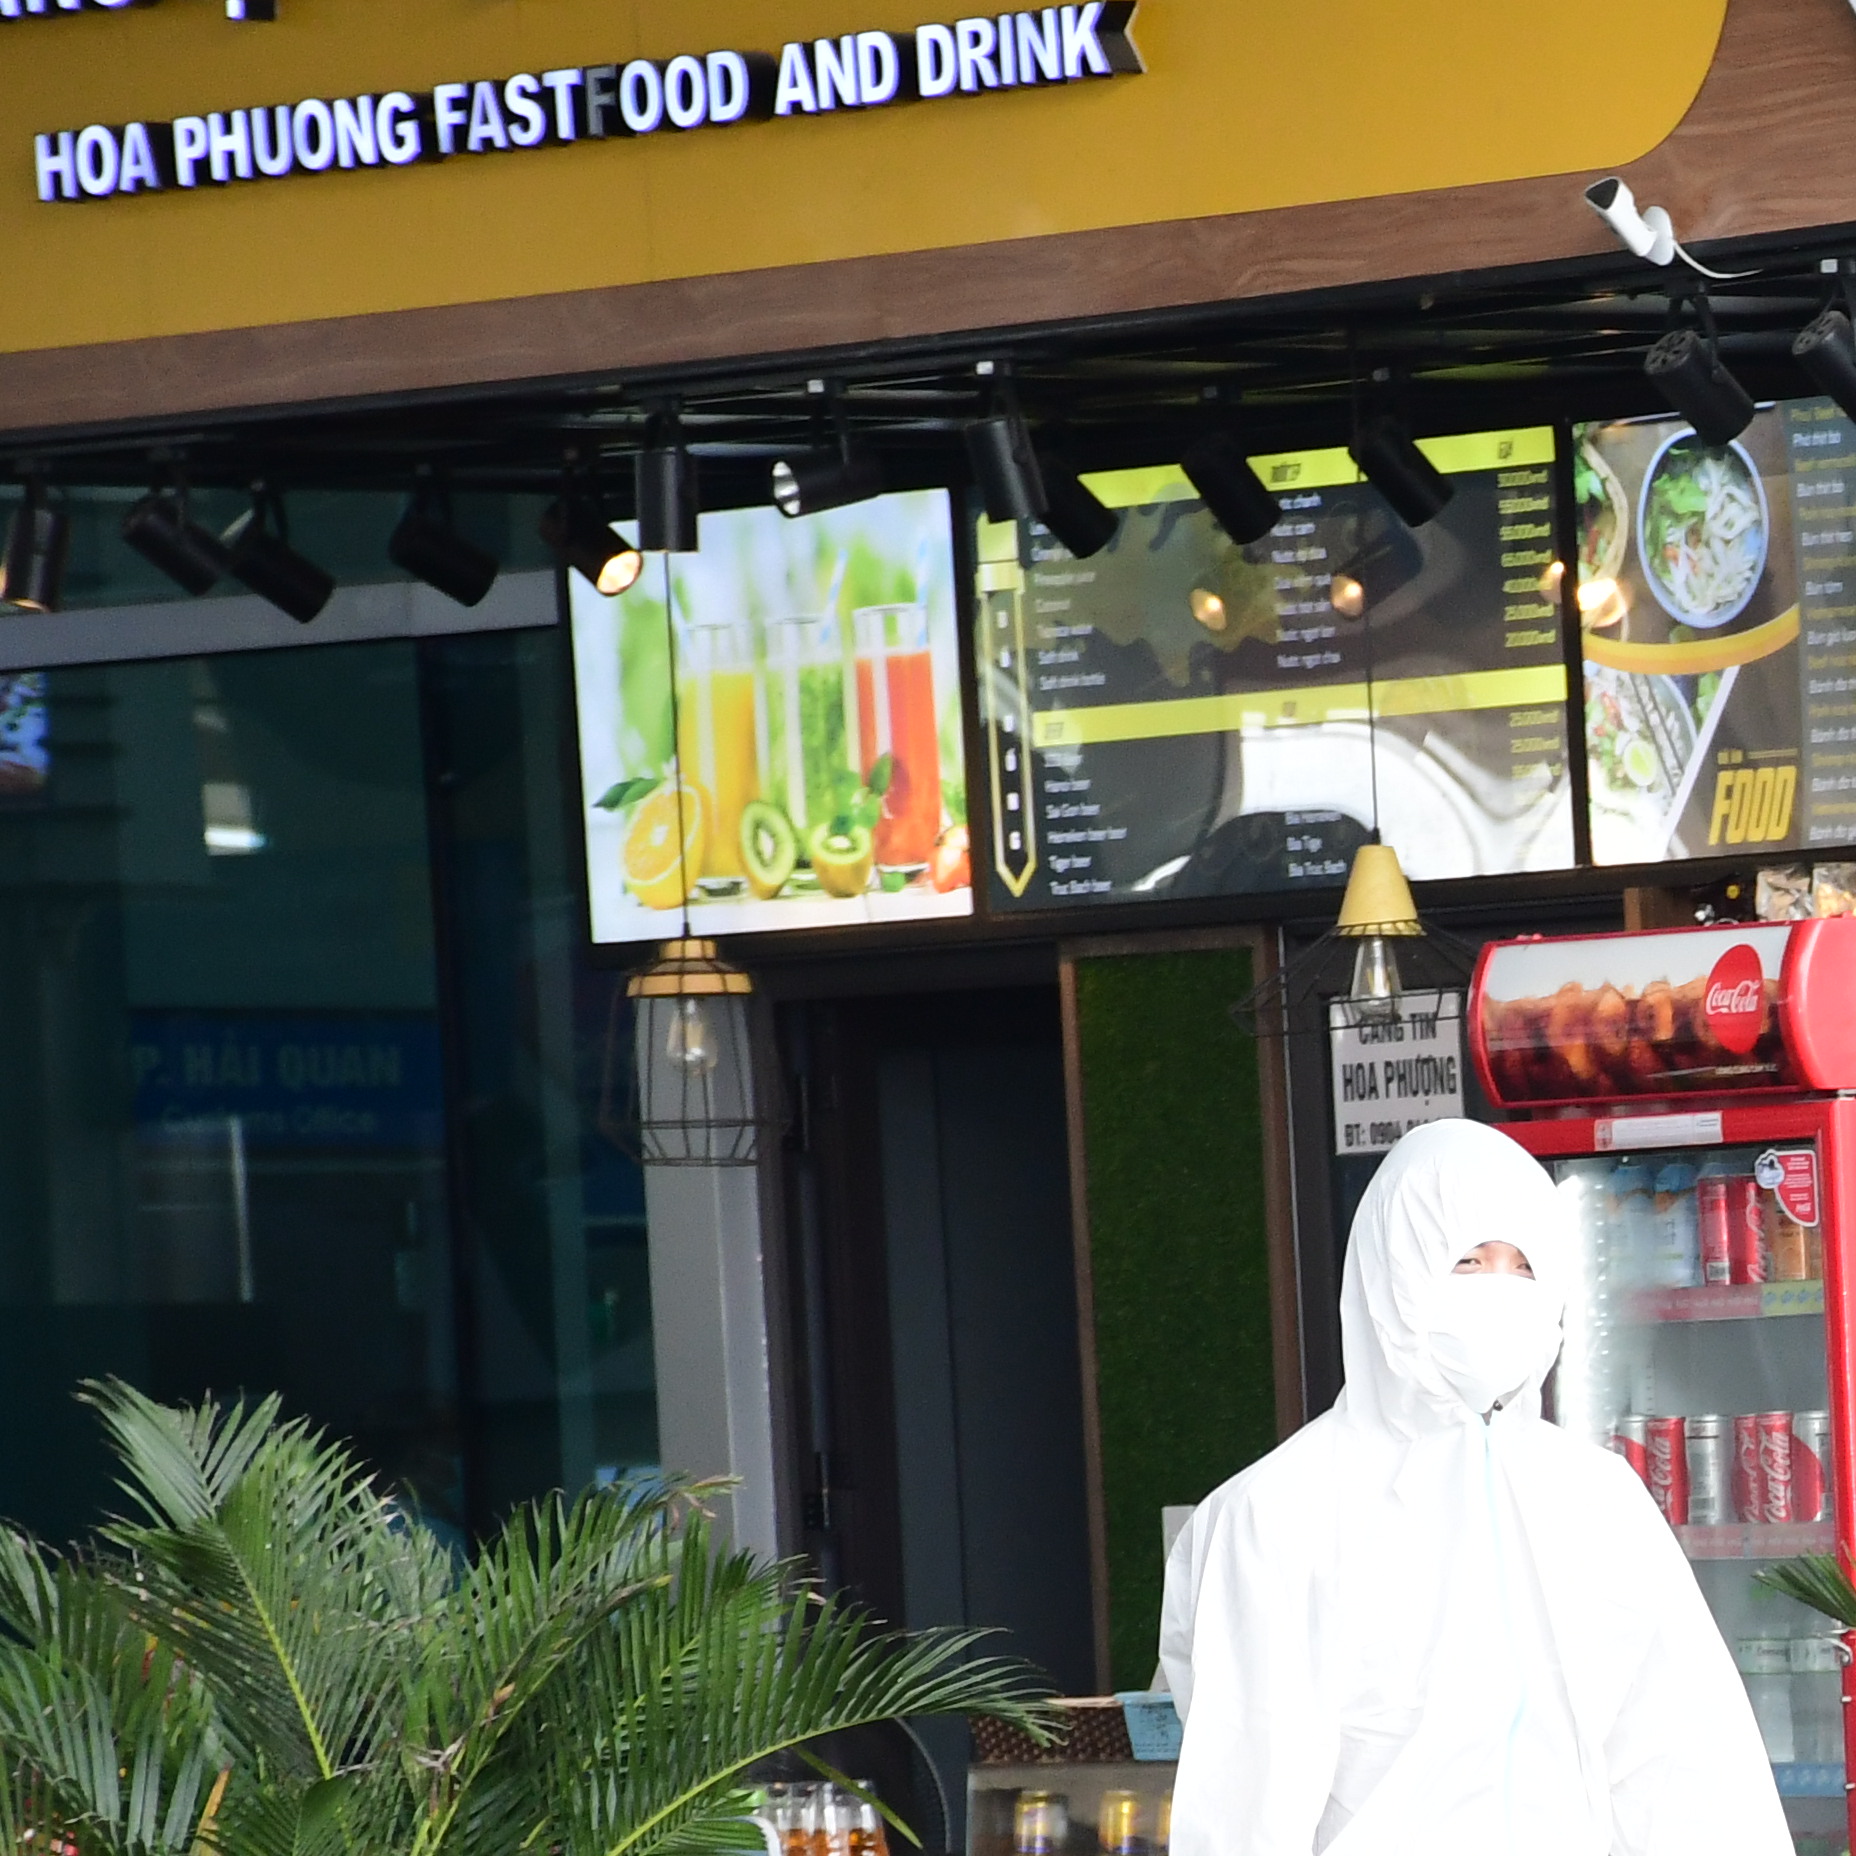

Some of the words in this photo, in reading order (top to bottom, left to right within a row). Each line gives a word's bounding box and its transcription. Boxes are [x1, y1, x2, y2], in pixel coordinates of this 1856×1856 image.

[35, 122, 160, 201] HOA
[173, 90, 422, 188] PHUONG
[774, 34, 901, 116] AND
[916, 2, 1110, 99] DRINK
[1708, 765, 1797, 847] FOOD
[1706, 980, 1763, 1016] Coca-Cola
[1342, 1061, 1380, 1102] HOA
